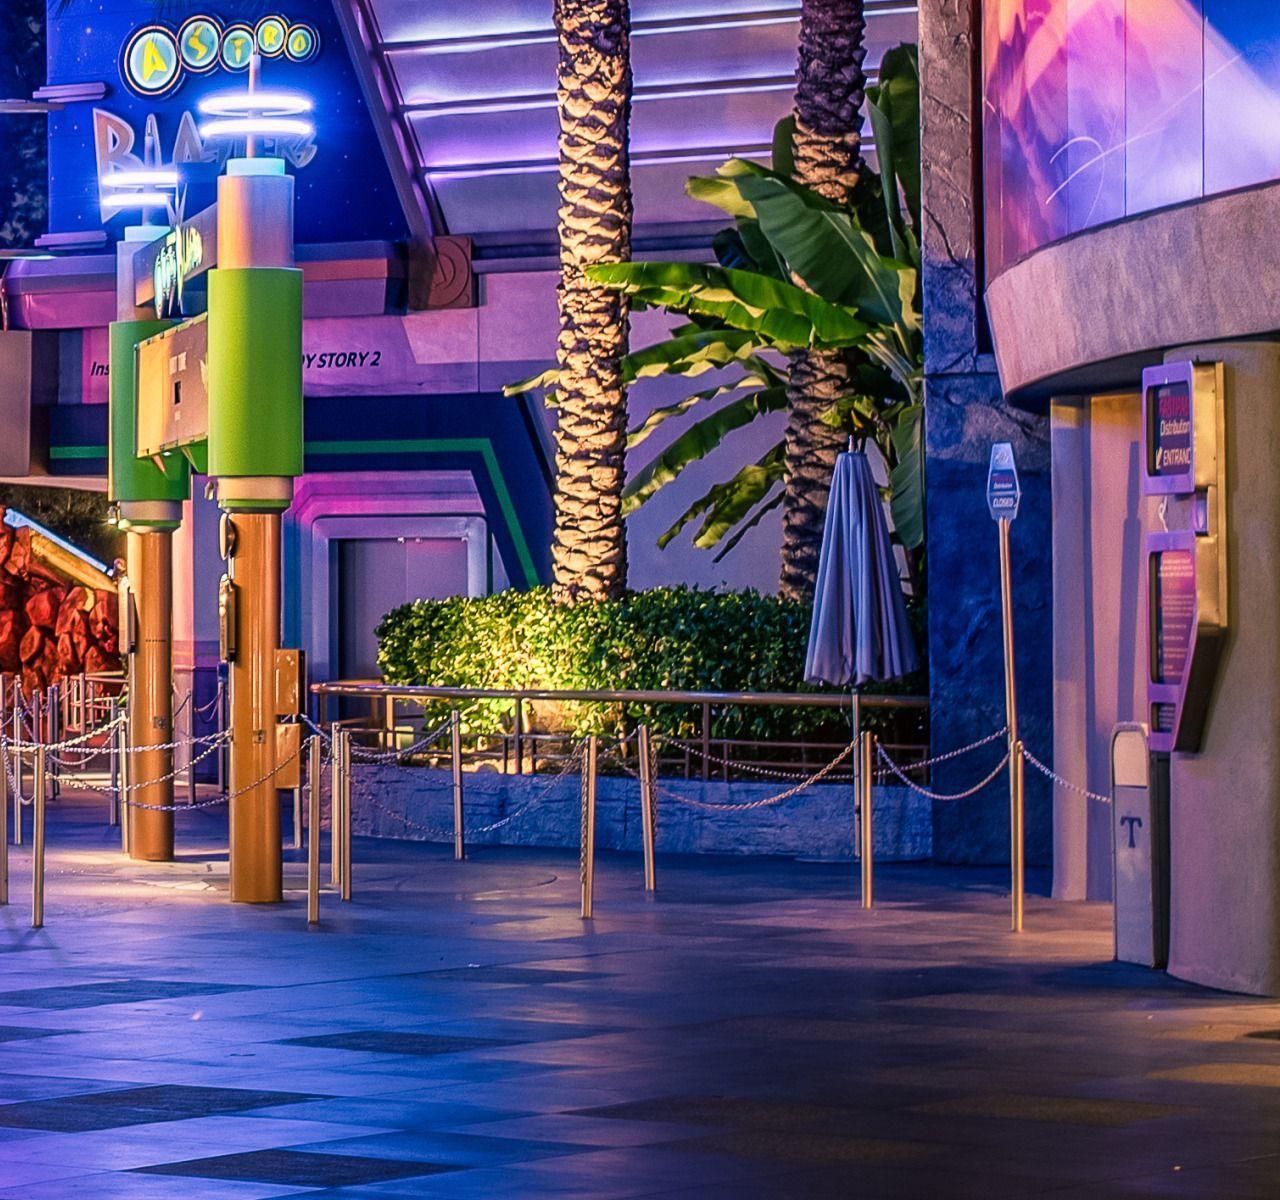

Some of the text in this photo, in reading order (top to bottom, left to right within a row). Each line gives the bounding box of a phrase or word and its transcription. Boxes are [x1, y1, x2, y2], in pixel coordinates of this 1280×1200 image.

[142, 24, 307, 82] ASTRO
[316, 351, 368, 369] STORY
[370, 350, 382, 367] 2
[1163, 447, 1191, 467] ENTRANC
